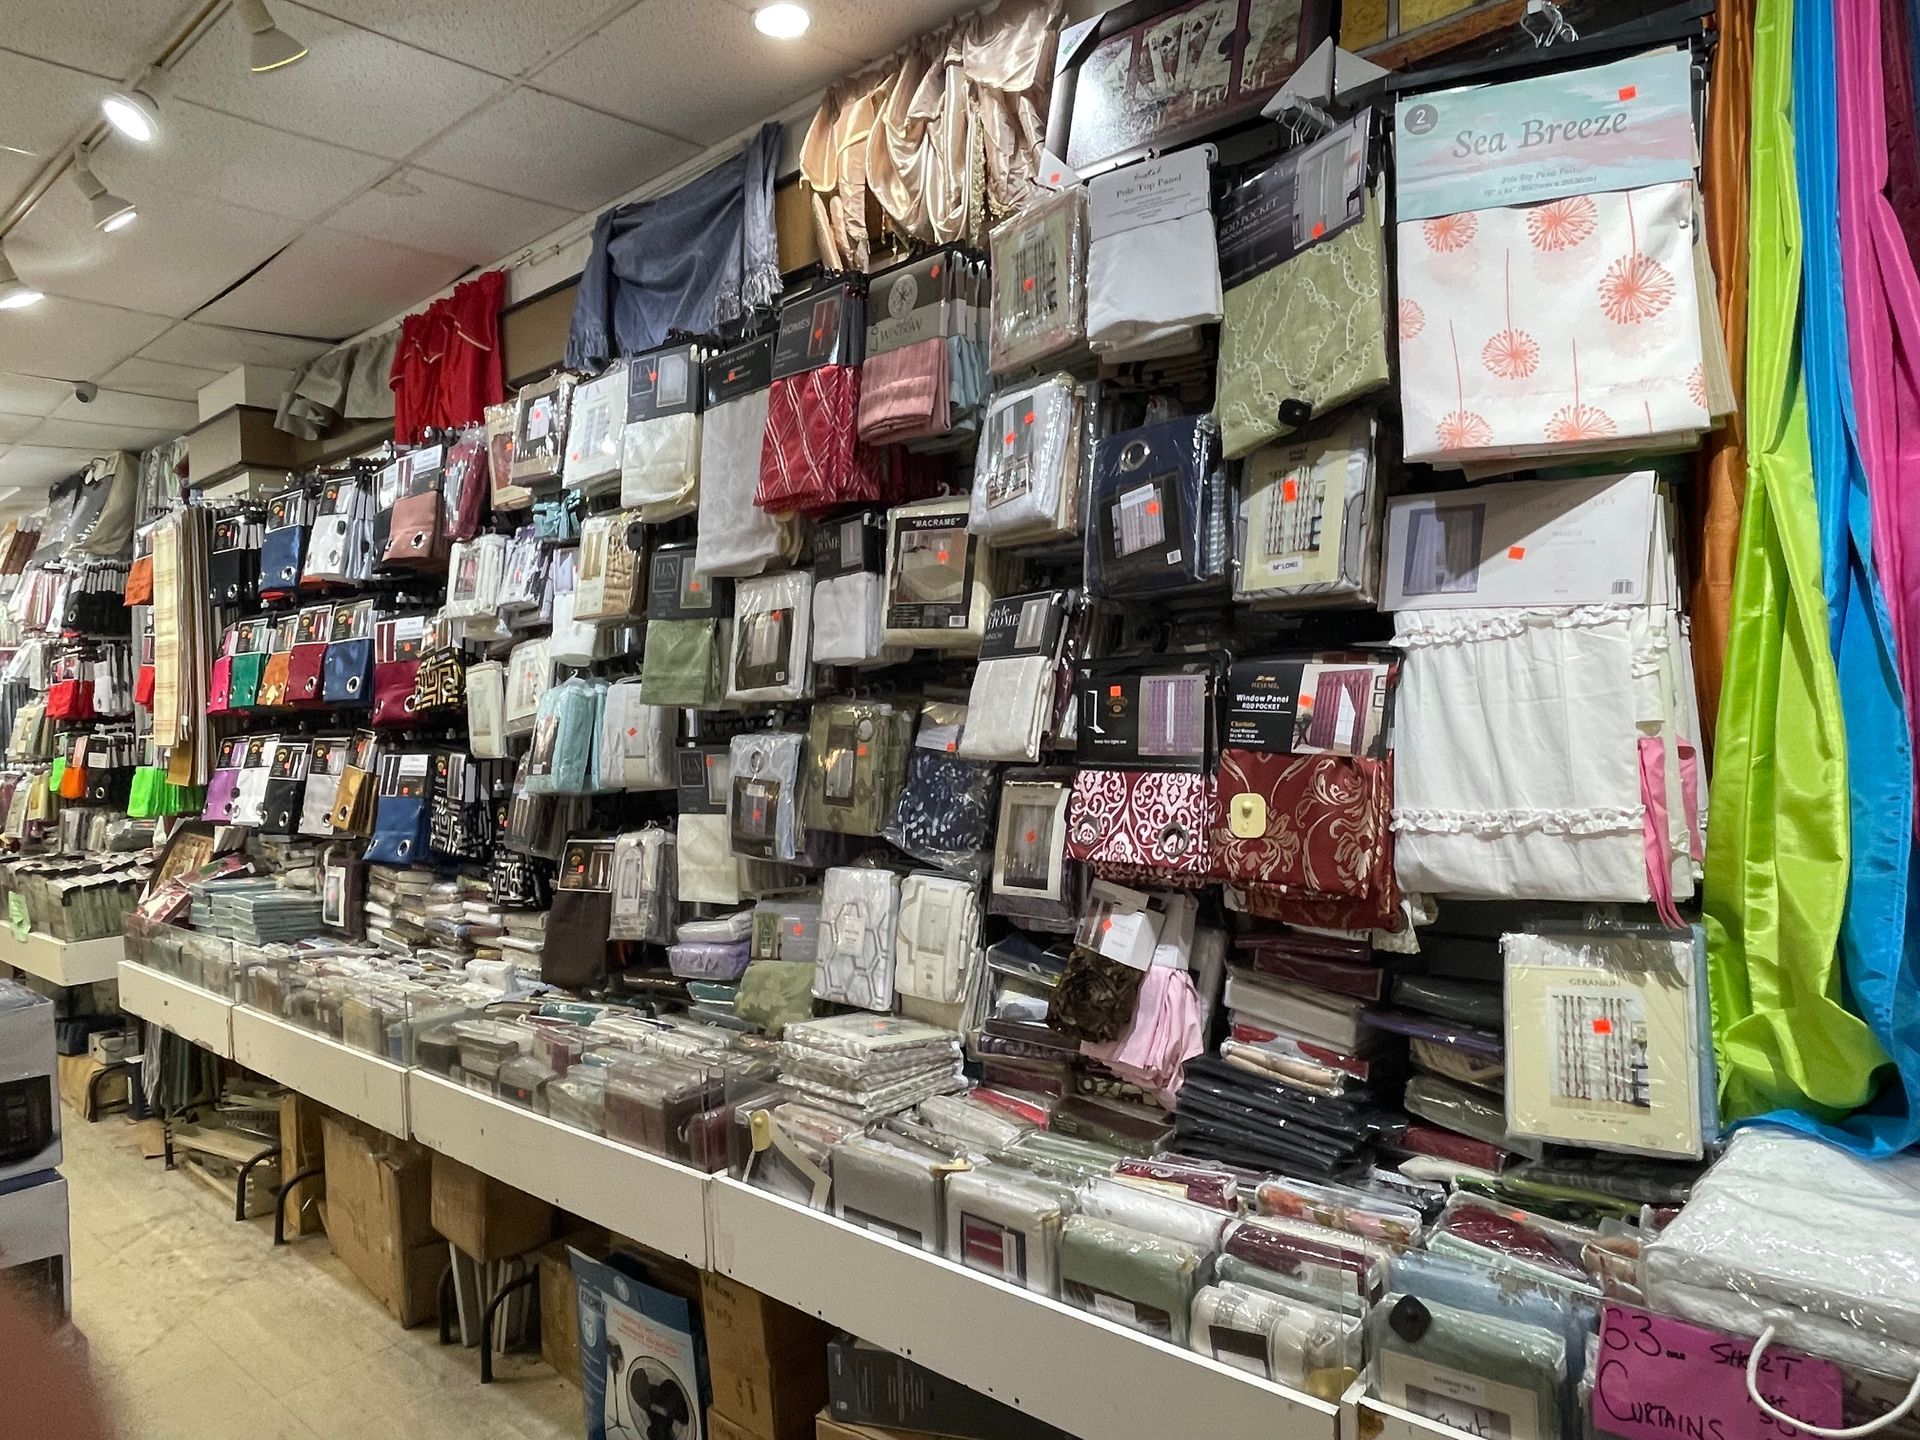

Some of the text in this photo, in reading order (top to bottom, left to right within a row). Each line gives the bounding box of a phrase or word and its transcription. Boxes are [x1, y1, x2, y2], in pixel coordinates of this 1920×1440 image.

[1416, 109, 1426, 125] 2
[1452, 111, 1628, 159] Sea Breeze
[1138, 182, 1155, 194] Top
[1157, 173, 1182, 187] Panel
[987, 613, 1021, 630] HOME
[1236, 693, 1289, 703] Window Panel
[1255, 702, 1281, 710] POCKET
